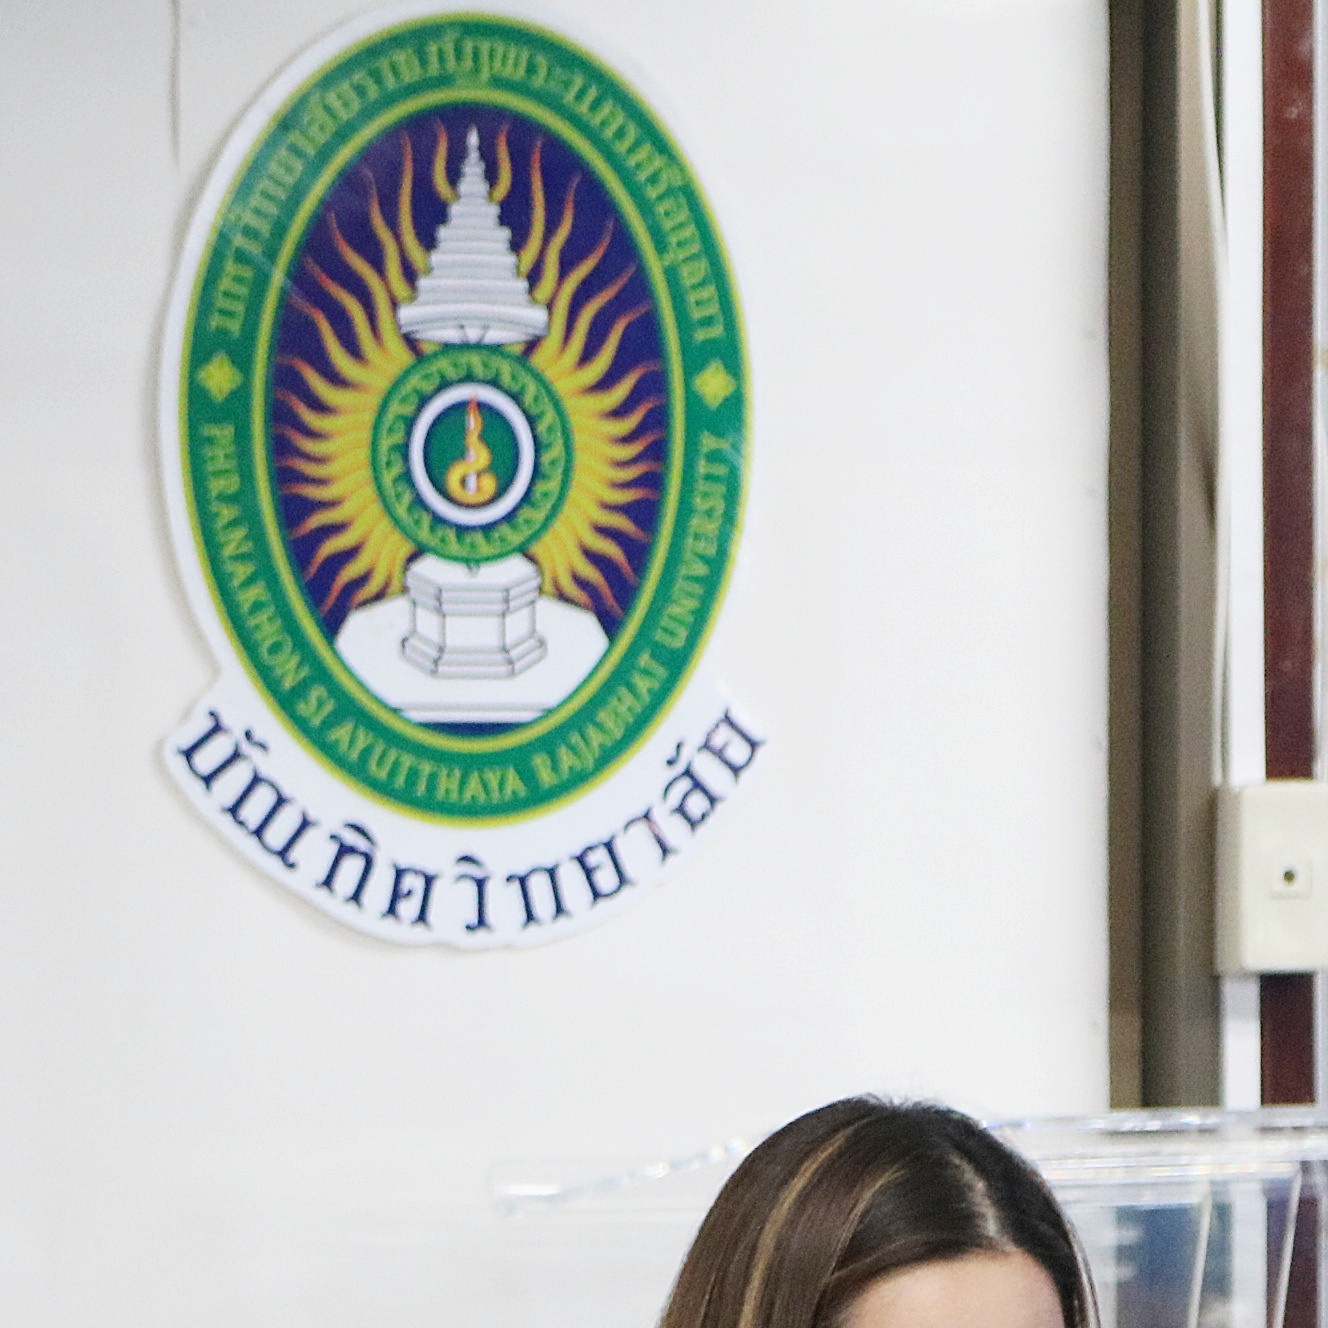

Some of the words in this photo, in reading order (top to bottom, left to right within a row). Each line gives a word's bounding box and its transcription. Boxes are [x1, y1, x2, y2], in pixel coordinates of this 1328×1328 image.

[199, 423, 310, 692] PHRANAKHON
[295, 685, 336, 727] SI
[327, 718, 528, 805] AYUTTHAYA
[530, 649, 669, 788] RAJABHAT
[654, 430, 733, 650] UNIVERSITY
[175, 707, 767, 932] บัณฑิตวิทยาลัย
